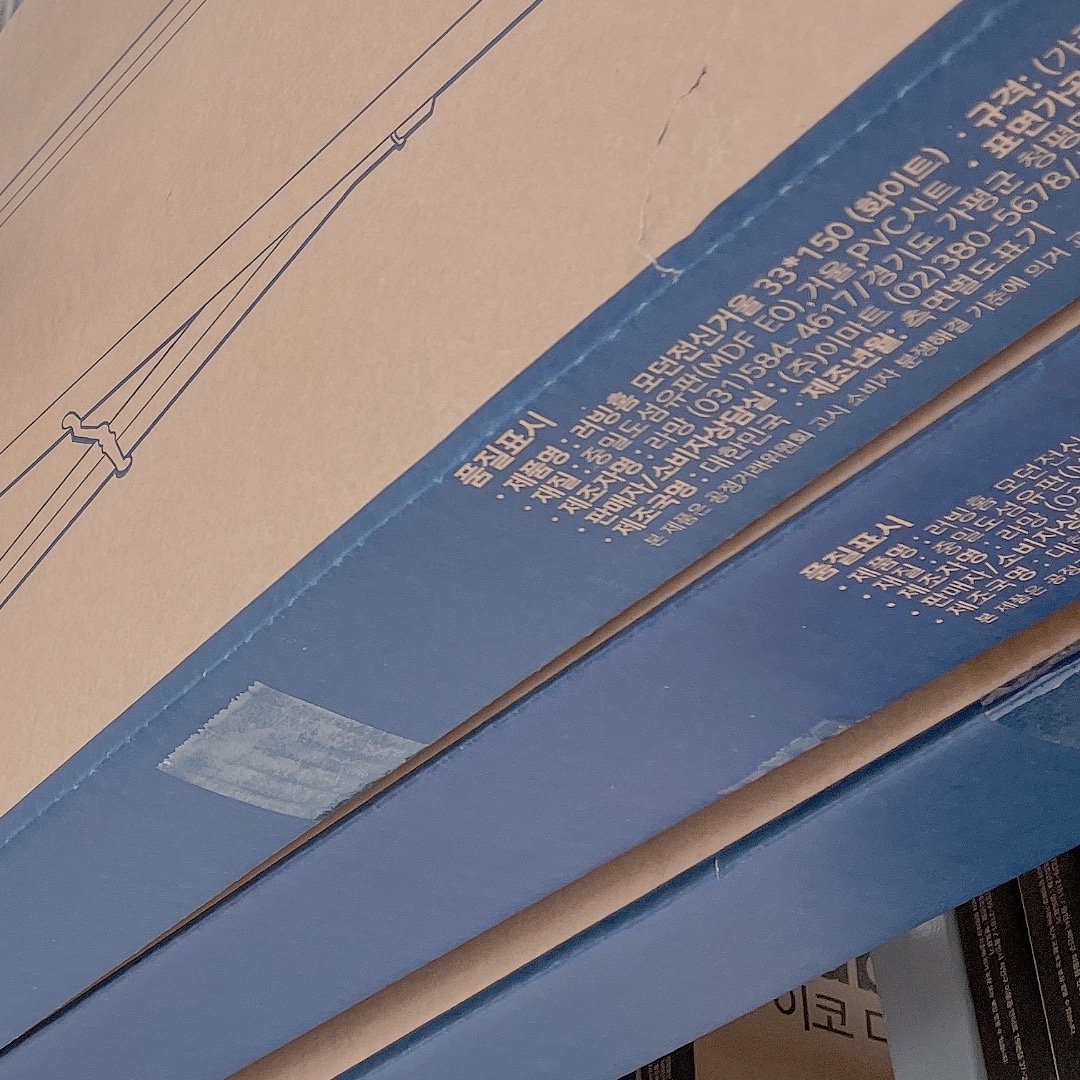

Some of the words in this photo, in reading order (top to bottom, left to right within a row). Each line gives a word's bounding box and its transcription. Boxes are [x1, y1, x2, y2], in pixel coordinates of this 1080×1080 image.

[558, 455, 645, 515] 제조자명
[936, 169, 1022, 231] 가평군
[1016, 109, 1080, 169] 청평
[902, 220, 1054, 328] 측면별도표기
[503, 444, 571, 493] 제품명
[574, 391, 640, 440] 러빙홈
[631, 293, 764, 394] 모던전신거울
[845, 146, 950, 224] (화이트)
[583, 389, 777, 526] 판매자/소비자상담실
[777, 305, 891, 384] (주)이마트
[644, 532, 666, 548] 본
[663, 503, 705, 534] 제품은
[707, 430, 813, 504] 공정거래위원회
[816, 405, 848, 430] 고시
[848, 368, 899, 404] 소비자
[894, 317, 971, 369] 분쟁해결
[968, 275, 1029, 317] 기준에
[1025, 247, 1069, 276] 의거
[454, 410, 558, 489] 품질표시
[530, 471, 582, 504] 재질
[611, 479, 698, 537] 제조국명
[699, 413, 790, 473] 대한민국
[800, 514, 913, 582] 품질표시
[849, 543, 918, 583] 제품명
[927, 496, 997, 536] 러빙홈
[872, 562, 925, 591] 재질
[898, 547, 988, 600] 제조자명
[947, 565, 1036, 616] 제조국명
[975, 611, 999, 625] 본
[998, 586, 1041, 611] 제품은
